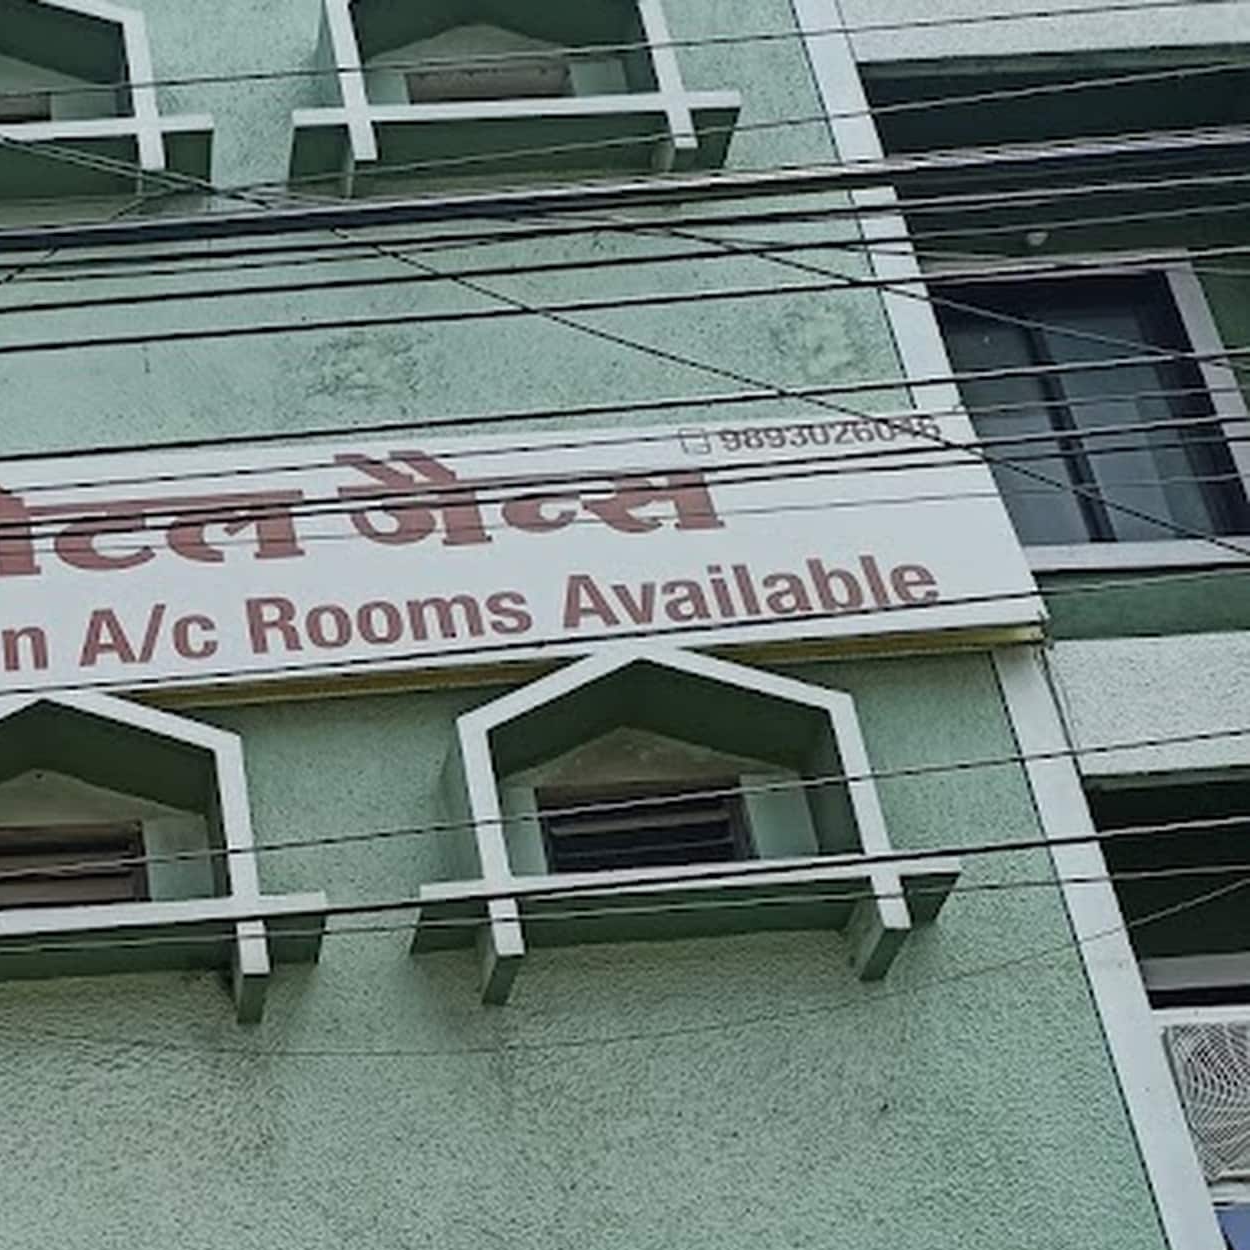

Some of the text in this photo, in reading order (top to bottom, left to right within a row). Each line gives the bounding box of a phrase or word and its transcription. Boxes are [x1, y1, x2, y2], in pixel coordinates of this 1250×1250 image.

[333, 450, 726, 546] जैन्स
[78, 603, 218, 667] A/c
[245, 589, 534, 654] Rooms
[562, 554, 940, 629] Available
